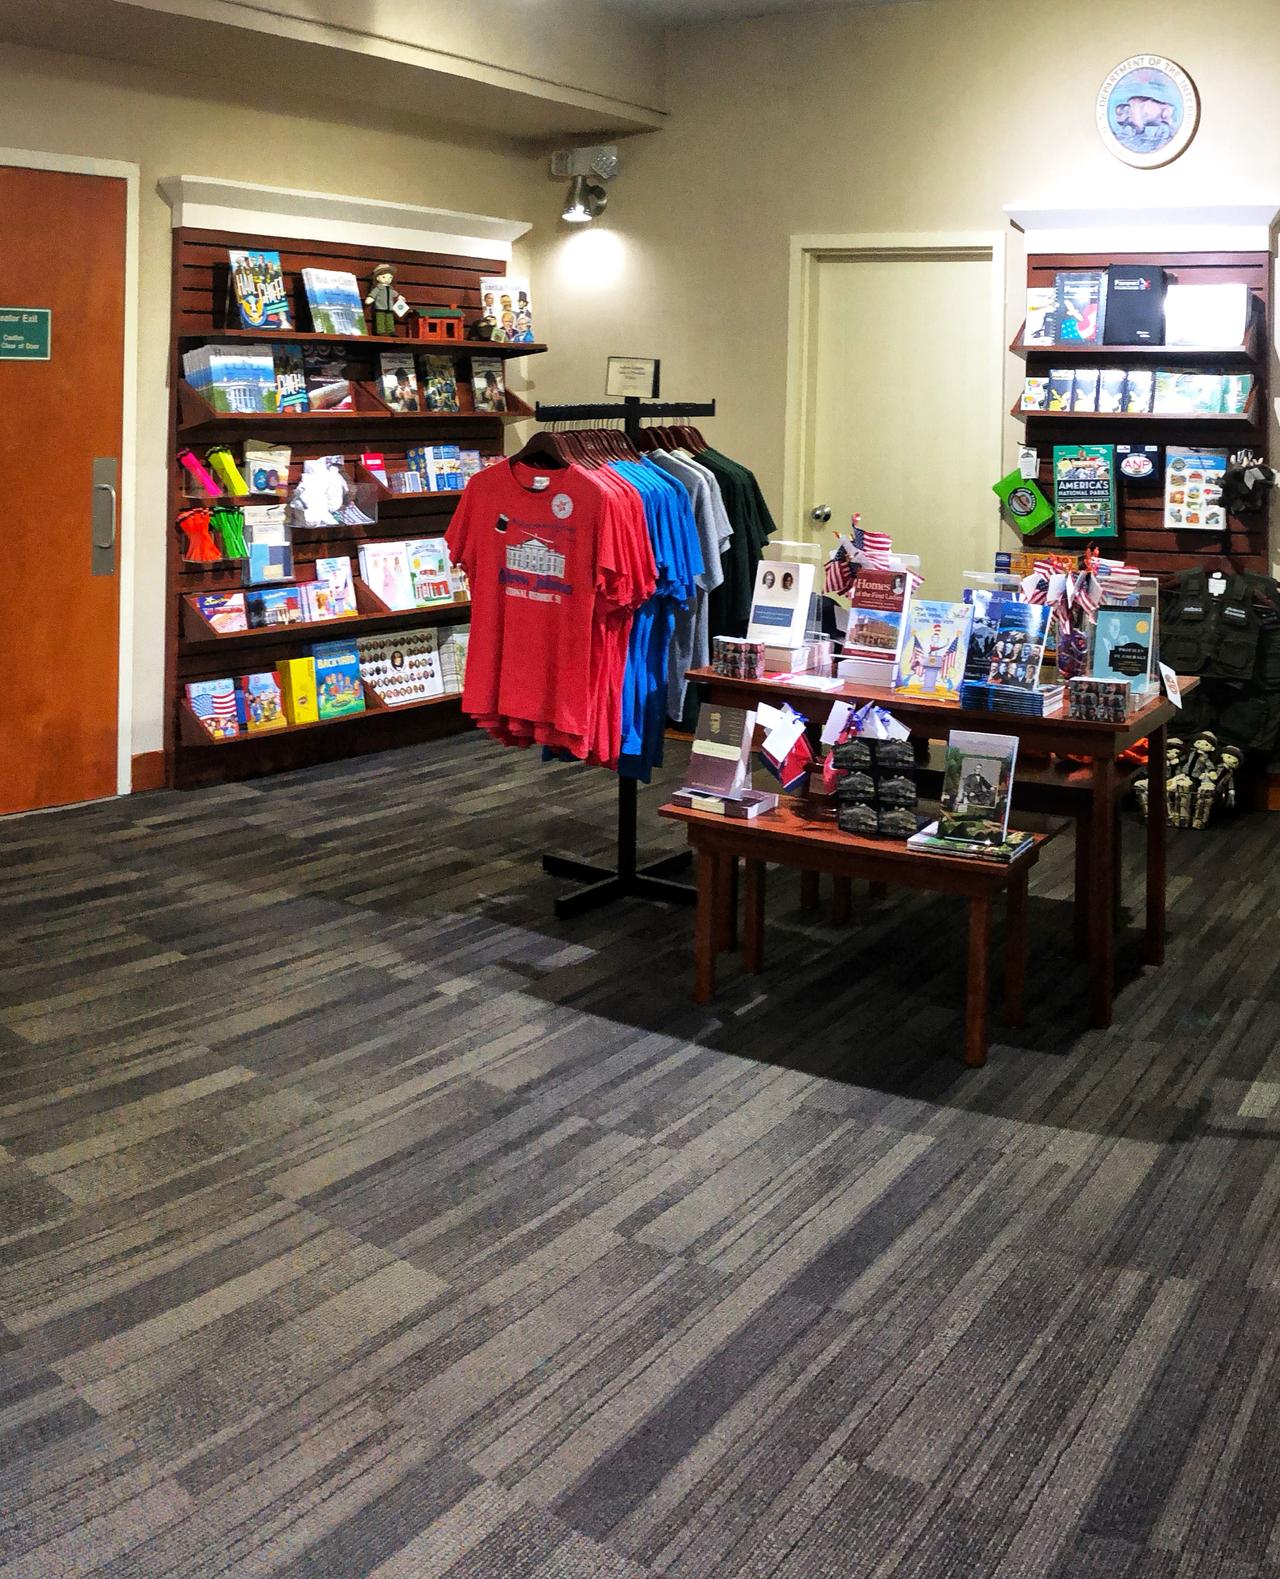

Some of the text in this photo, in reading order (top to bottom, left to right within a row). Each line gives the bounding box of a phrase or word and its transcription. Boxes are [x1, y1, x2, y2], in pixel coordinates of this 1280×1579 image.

[1099, 58, 1145, 107] DEPARTMENT
[1149, 57, 1162, 66] OF
[1165, 63, 1180, 78] THE
[22, 314, 38, 323] Exit
[1124, 460, 1150, 468] ANP
[1059, 480, 1109, 490] AMERICA'S
[857, 579, 891, 591] Homes
